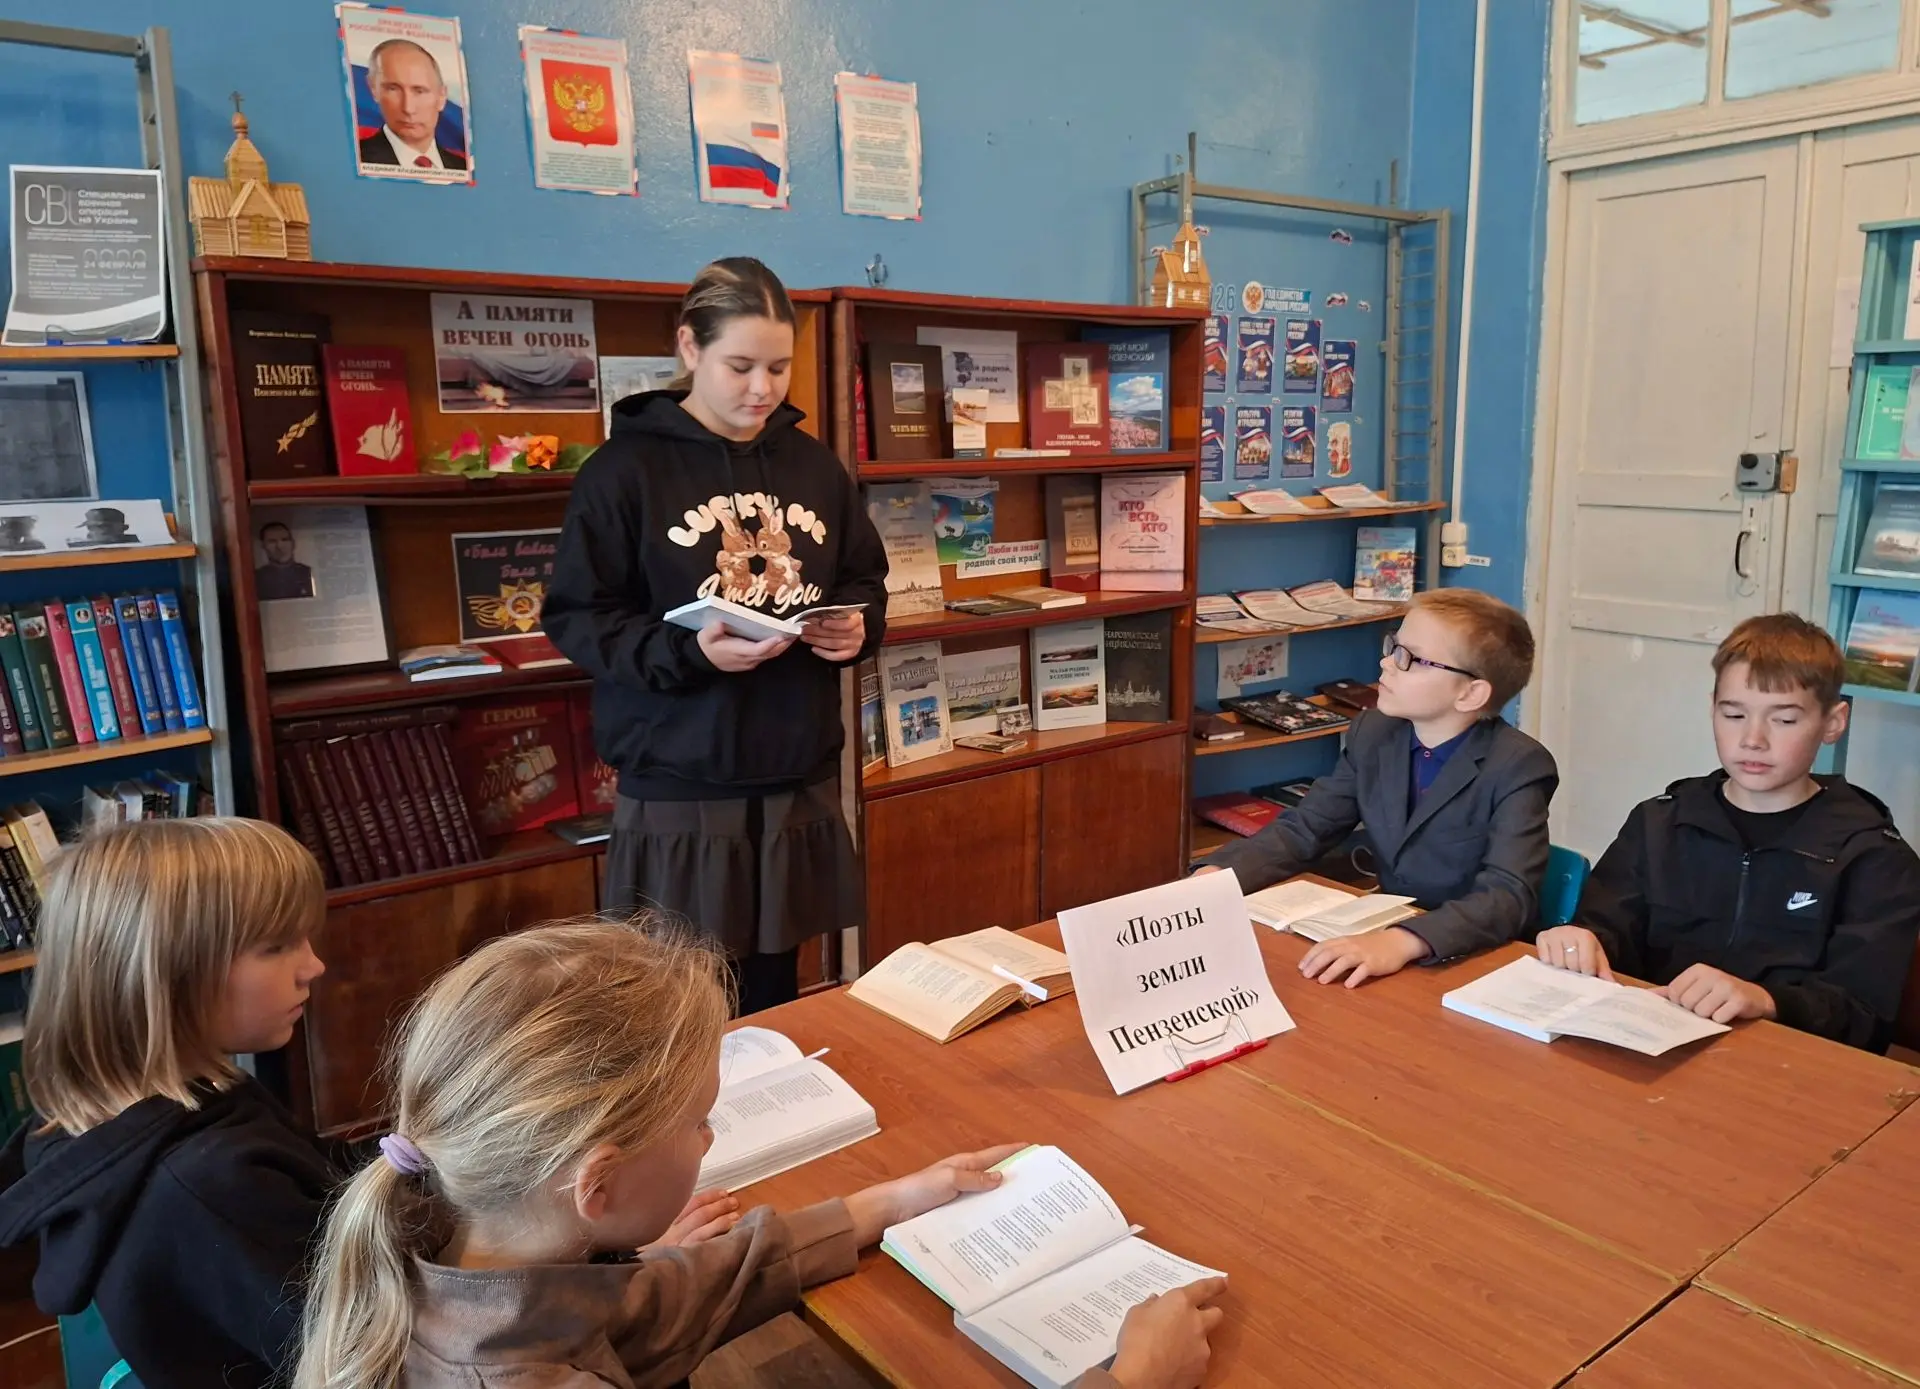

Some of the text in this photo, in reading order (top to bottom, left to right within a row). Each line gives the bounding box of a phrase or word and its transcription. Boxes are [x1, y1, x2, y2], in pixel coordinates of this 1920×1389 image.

[78, 189, 146, 200] Специальная
[78, 216, 138, 225] на Украине
[98, 261, 147, 270] ФЕВРАЛЯ
[457, 299, 574, 323] А ПАМЯТИ
[442, 329, 590, 348] ВЕЧЕН ОГОНЬ
[1118, 500, 1145, 511] КТО
[1128, 511, 1160, 522] ЕСТЬ
[1141, 522, 1168, 533] КТО
[988, 546, 1010, 554] Люби
[965, 553, 1041, 570] родной свой край!
[723, 578, 769, 607] met
[771, 582, 823, 615] you
[483, 705, 538, 724] ГЕРОИ
[1116, 906, 1204, 948] «Поэты
[1136, 955, 1207, 993] земли
[1107, 985, 1260, 1054] Пензенской»
